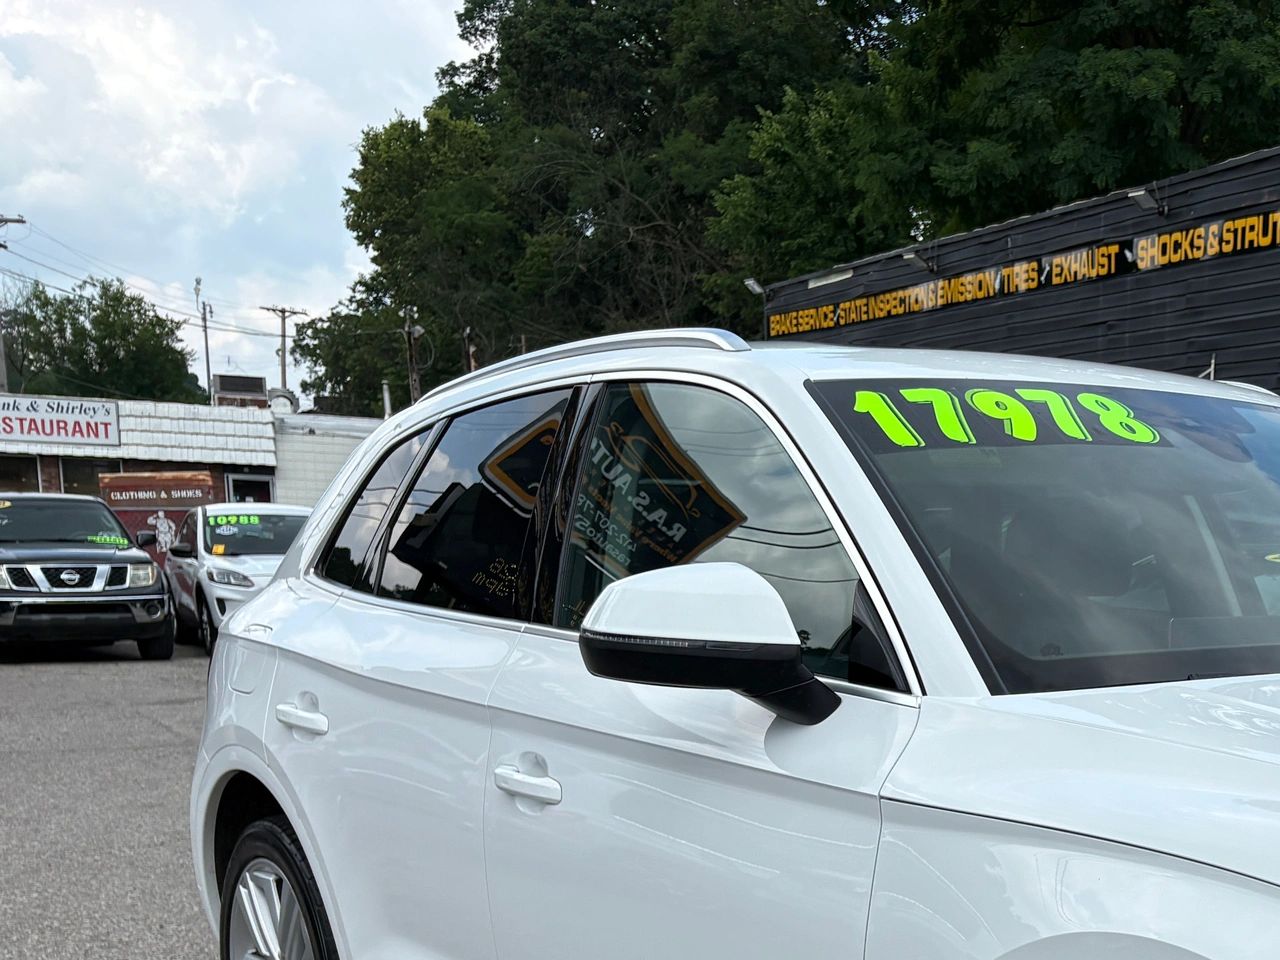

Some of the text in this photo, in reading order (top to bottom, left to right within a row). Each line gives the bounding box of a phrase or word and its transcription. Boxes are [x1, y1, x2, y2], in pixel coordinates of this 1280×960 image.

[769, 311, 798, 337] BRAKE
[798, 304, 836, 332] SERVICE
[839, 298, 868, 326] STATE
[868, 285, 928, 320] INSPECTION
[937, 270, 995, 305] EMISSION
[1002, 260, 1038, 294] TIRES
[1052, 244, 1119, 285] EXHAUST
[1137, 227, 1204, 270] SHOCKS
[1206, 224, 1221, 257] &
[2, 400, 111, 419] nk & Shirley's
[853, 388, 1161, 447] 17978
[0, 416, 112, 439] STAURANT
[111, 490, 156, 501] CLOTHING
[171, 489, 202, 499] SHOES
